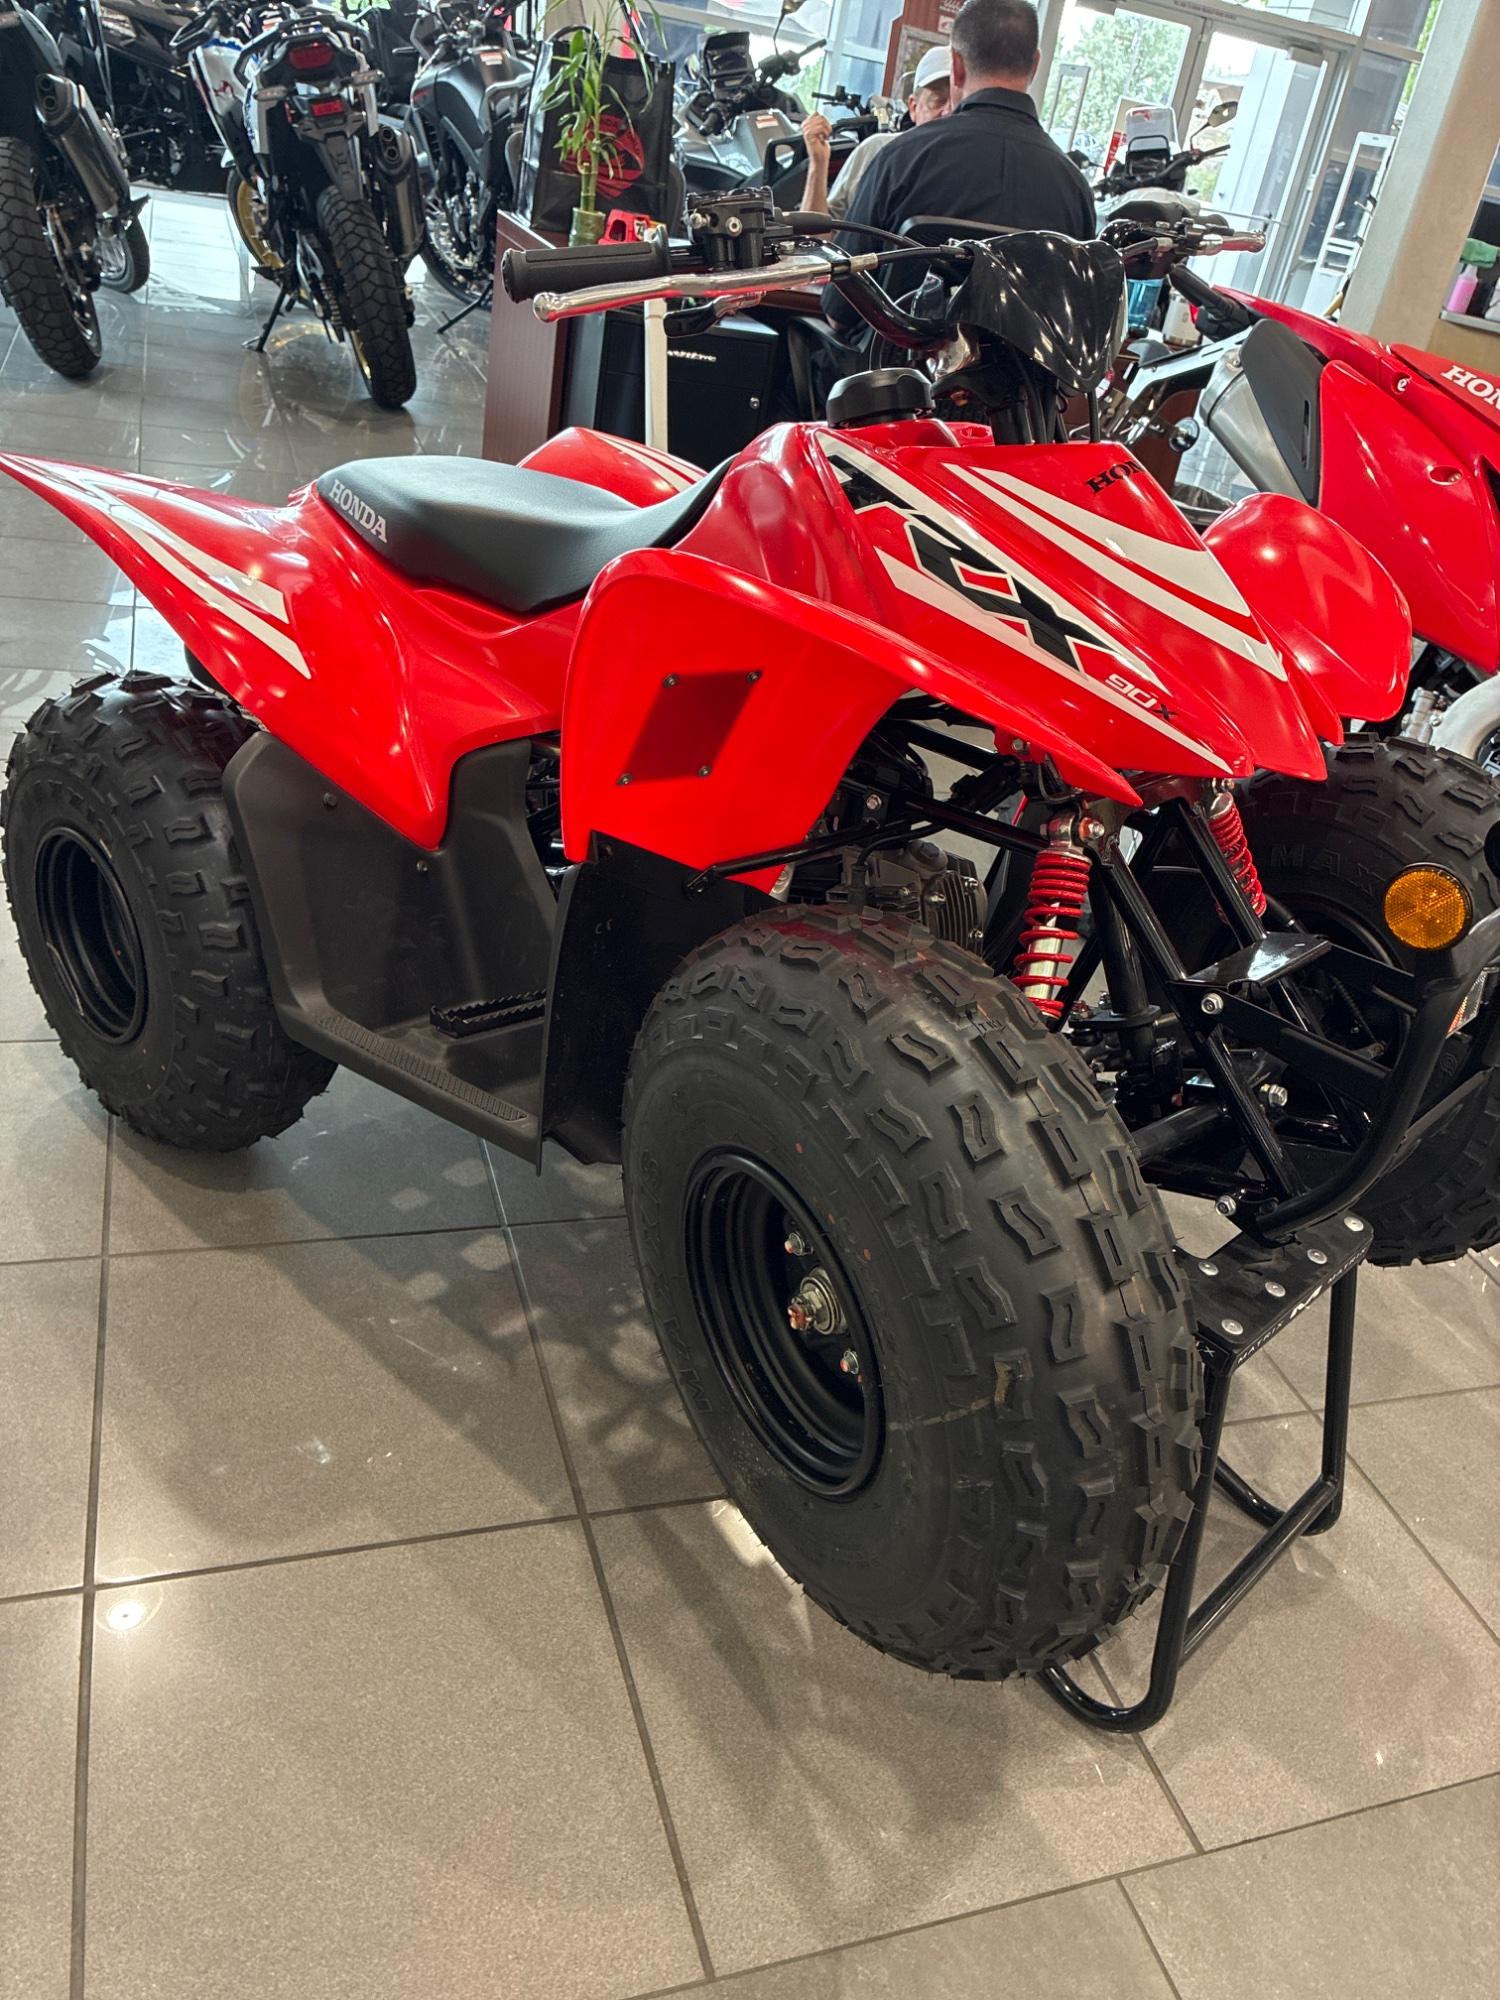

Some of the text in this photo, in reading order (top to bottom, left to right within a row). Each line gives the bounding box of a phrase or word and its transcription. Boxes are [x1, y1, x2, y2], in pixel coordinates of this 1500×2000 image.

[329, 478, 388, 544] HONDA
[1237, 1320, 1284, 1365] MATRIX
[1327, 1247, 1367, 1284] MATRIX
